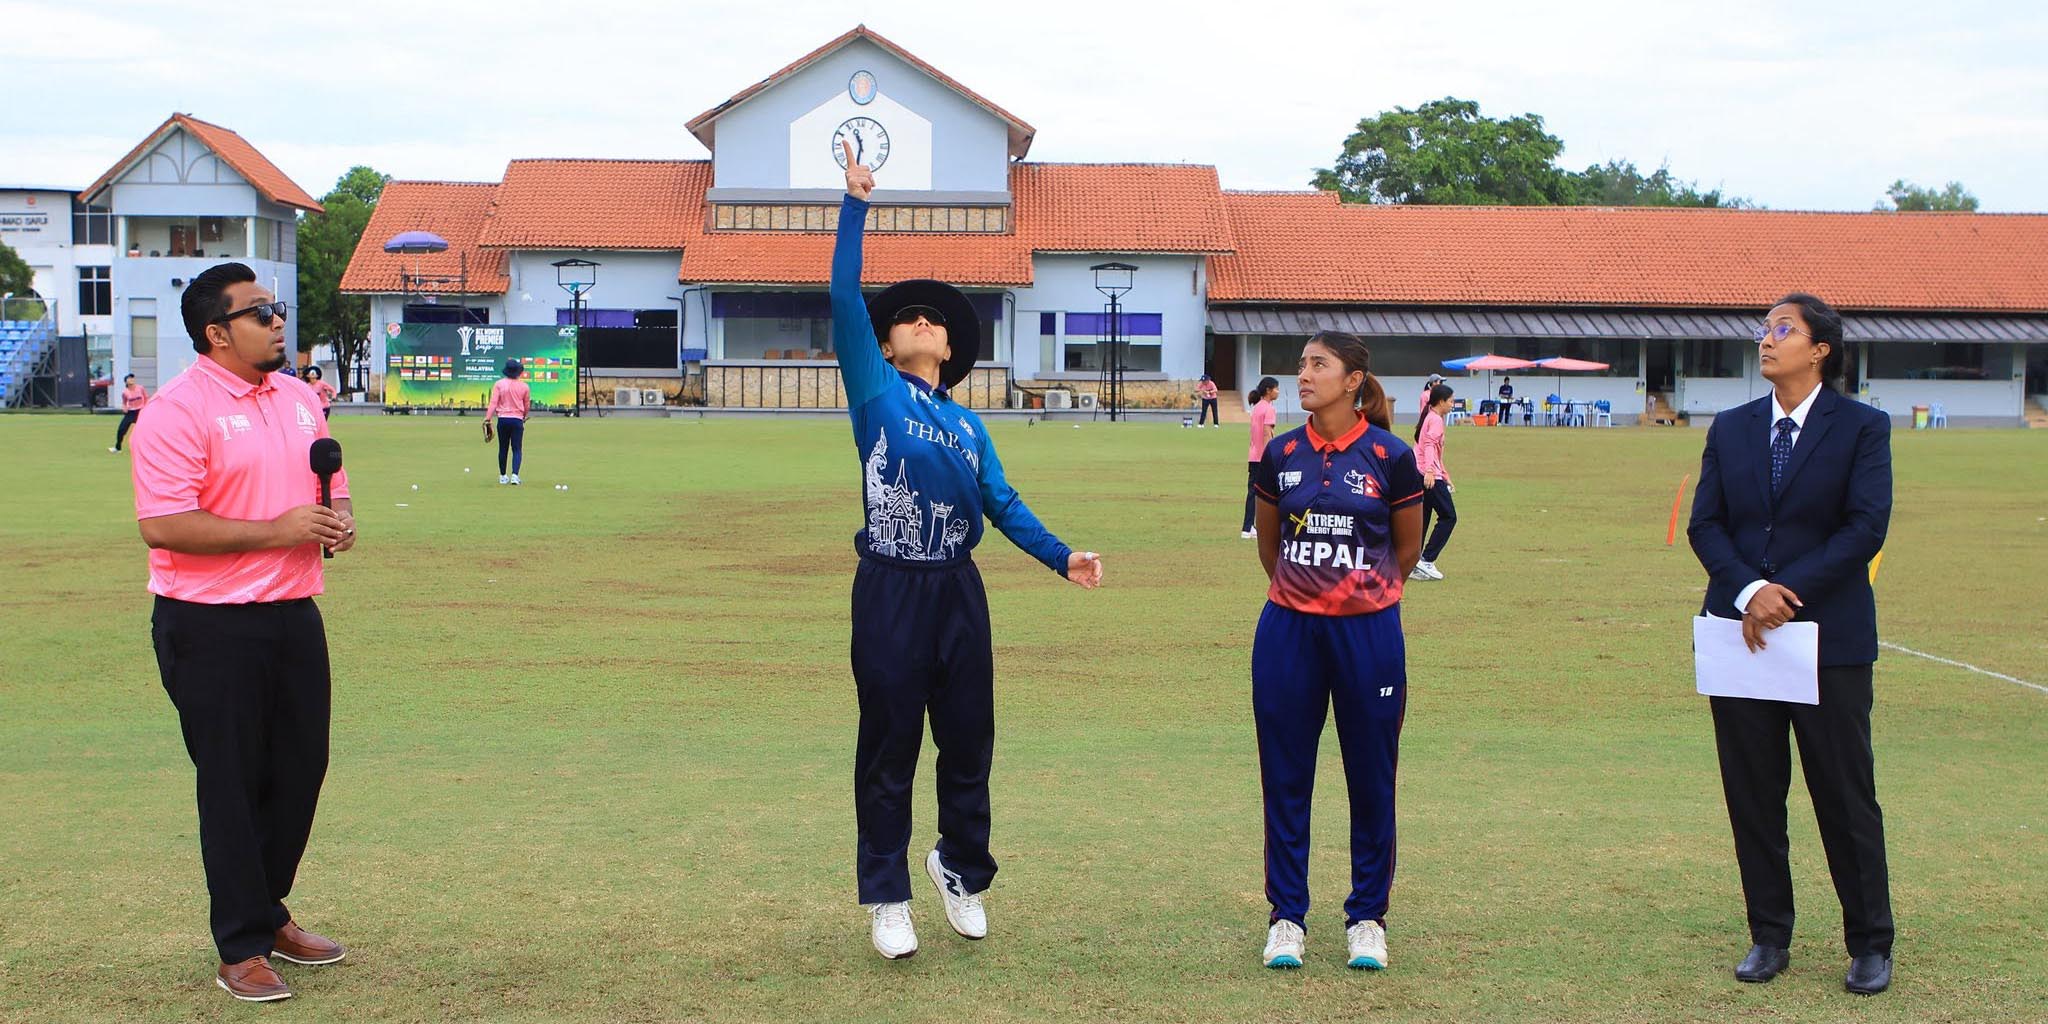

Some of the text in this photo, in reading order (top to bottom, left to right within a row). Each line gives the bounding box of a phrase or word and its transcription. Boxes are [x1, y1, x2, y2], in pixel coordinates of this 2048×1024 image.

[558, 327, 575, 336] ACC
[475, 335, 504, 345] PREMIER
[1307, 526, 1352, 537] ENERGY DRINK
